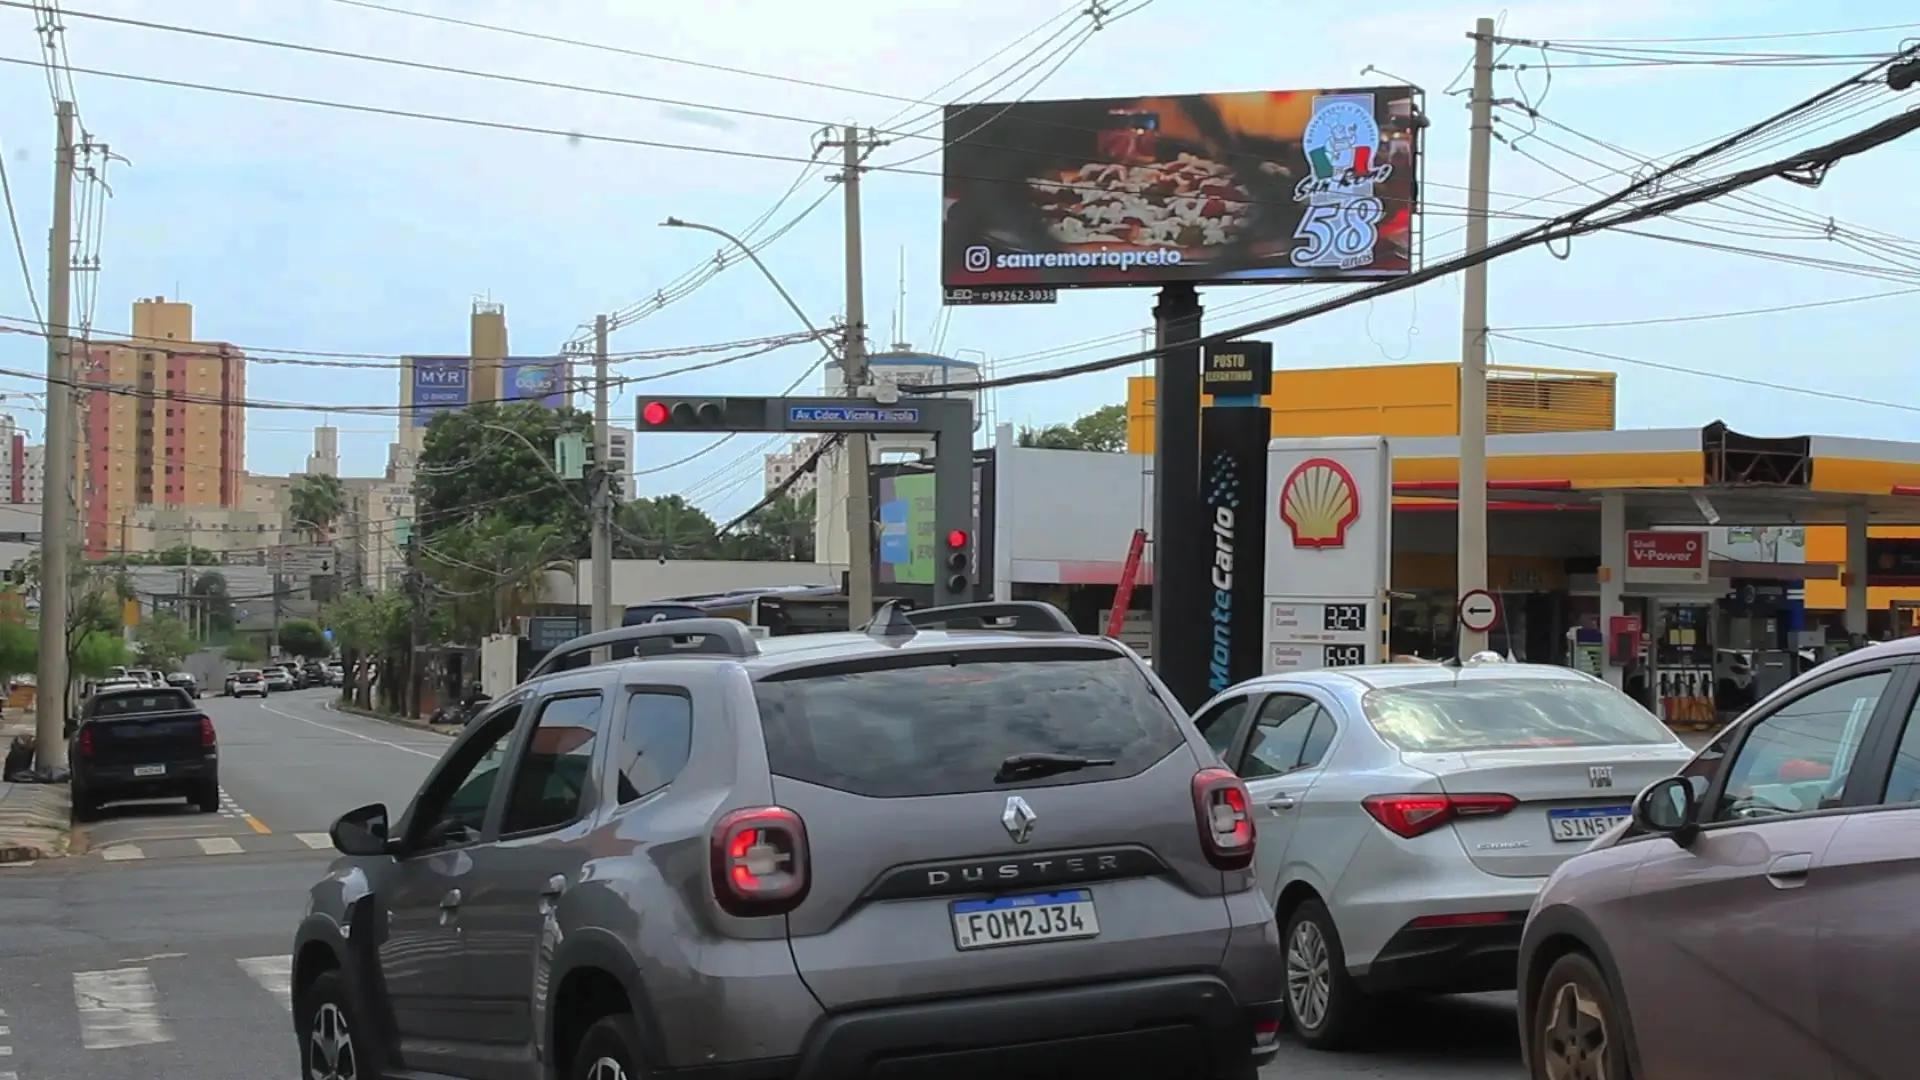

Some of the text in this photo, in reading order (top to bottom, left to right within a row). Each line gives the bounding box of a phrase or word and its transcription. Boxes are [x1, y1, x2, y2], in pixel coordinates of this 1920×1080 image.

[1291, 197, 1384, 267] 58
[996, 247, 1181, 271] sanremoriopreto
[1213, 354, 1245, 368] POSTO
[1633, 549, 1692, 561] V-Power
[928, 855, 1118, 886] DUSTER
[968, 904, 1084, 942] FOM2J34
